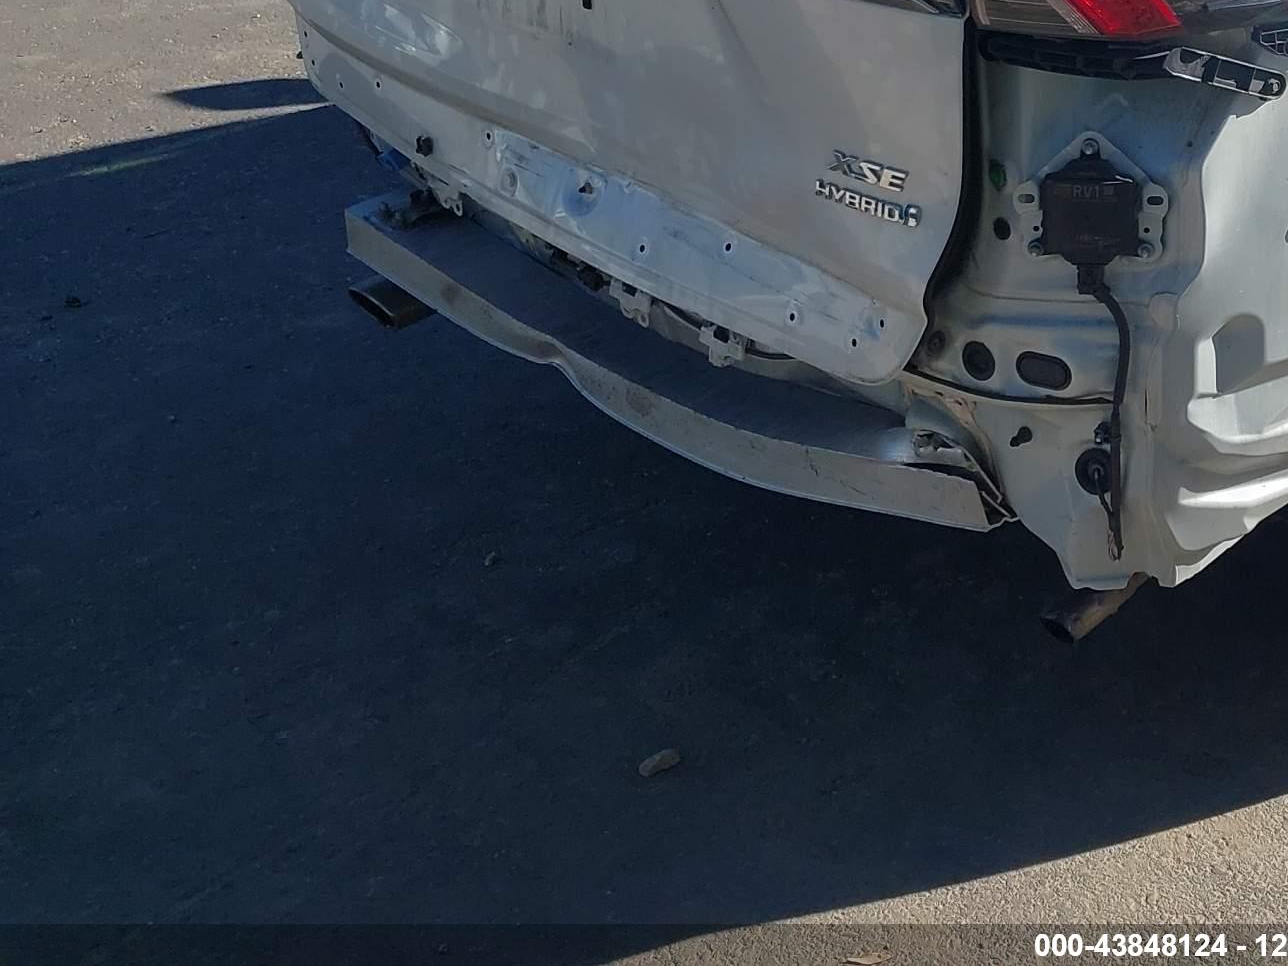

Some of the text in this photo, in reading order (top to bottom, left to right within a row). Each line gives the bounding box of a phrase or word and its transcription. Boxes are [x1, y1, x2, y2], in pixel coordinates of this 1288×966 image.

[827, 149, 909, 192] XSE
[1072, 184, 1100, 199] RV1
[815, 179, 902, 222] HYBRID
